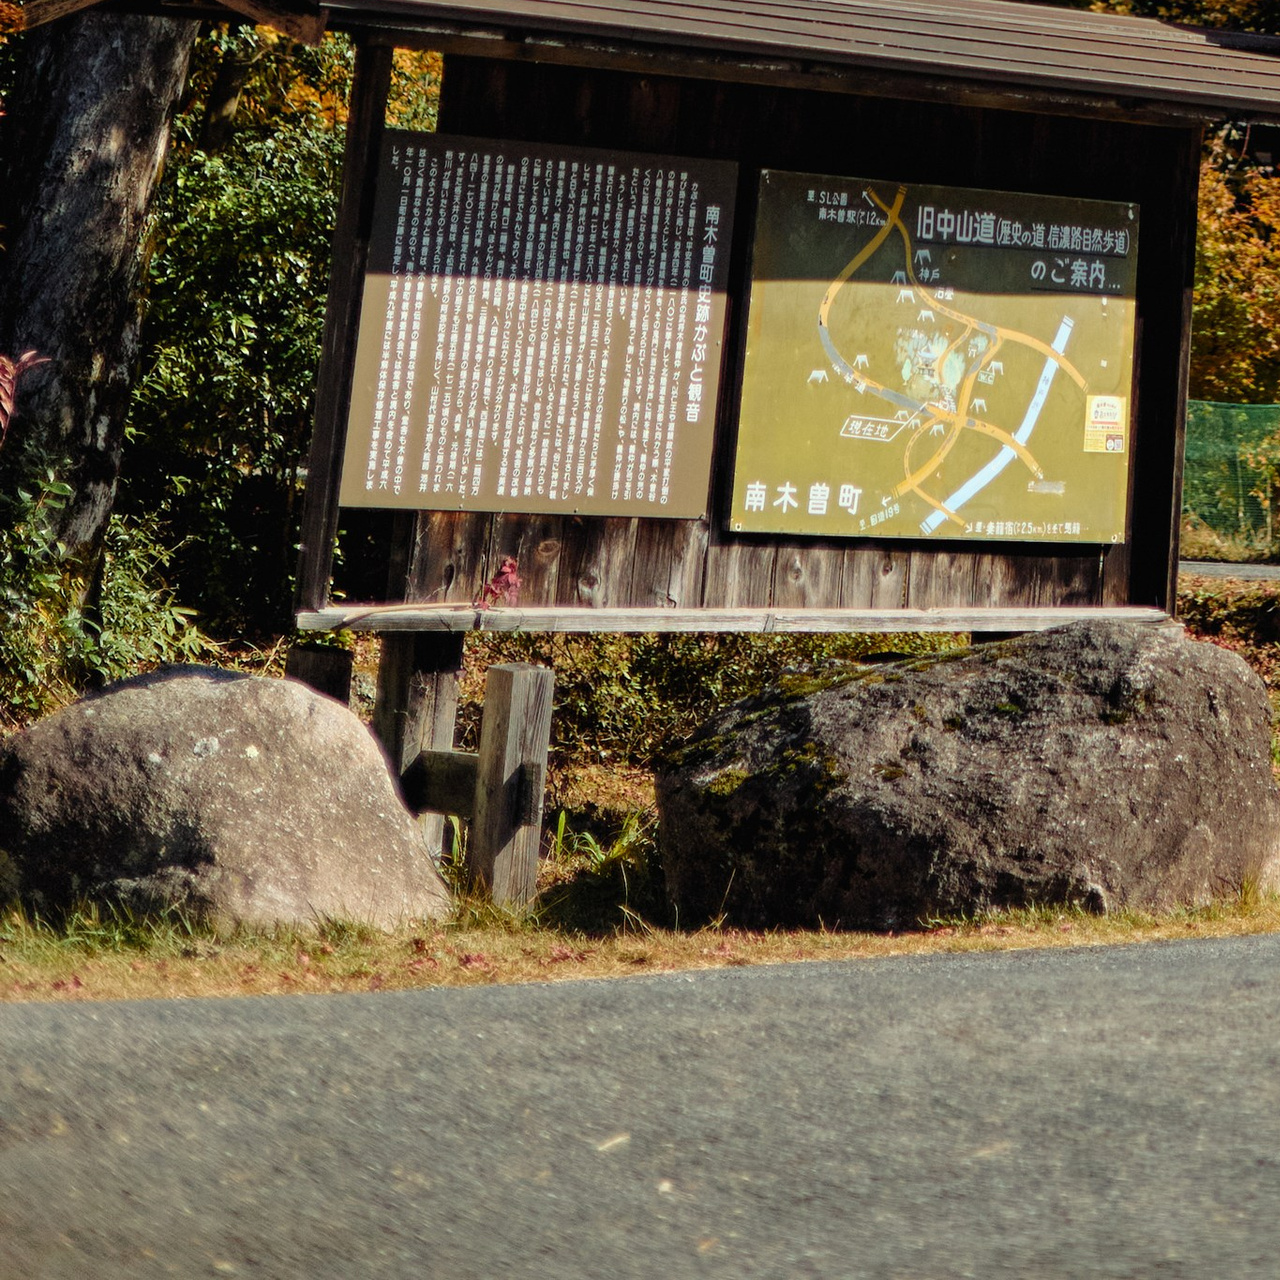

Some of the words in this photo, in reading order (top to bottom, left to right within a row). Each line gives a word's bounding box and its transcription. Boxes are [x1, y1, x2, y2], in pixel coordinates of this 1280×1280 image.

[389, 145, 401, 170] した。
[684, 204, 721, 423] 南木曽町史跡かぶと観音
[848, 420, 889, 438] 現在地
[744, 480, 863, 516] 南木曽町
